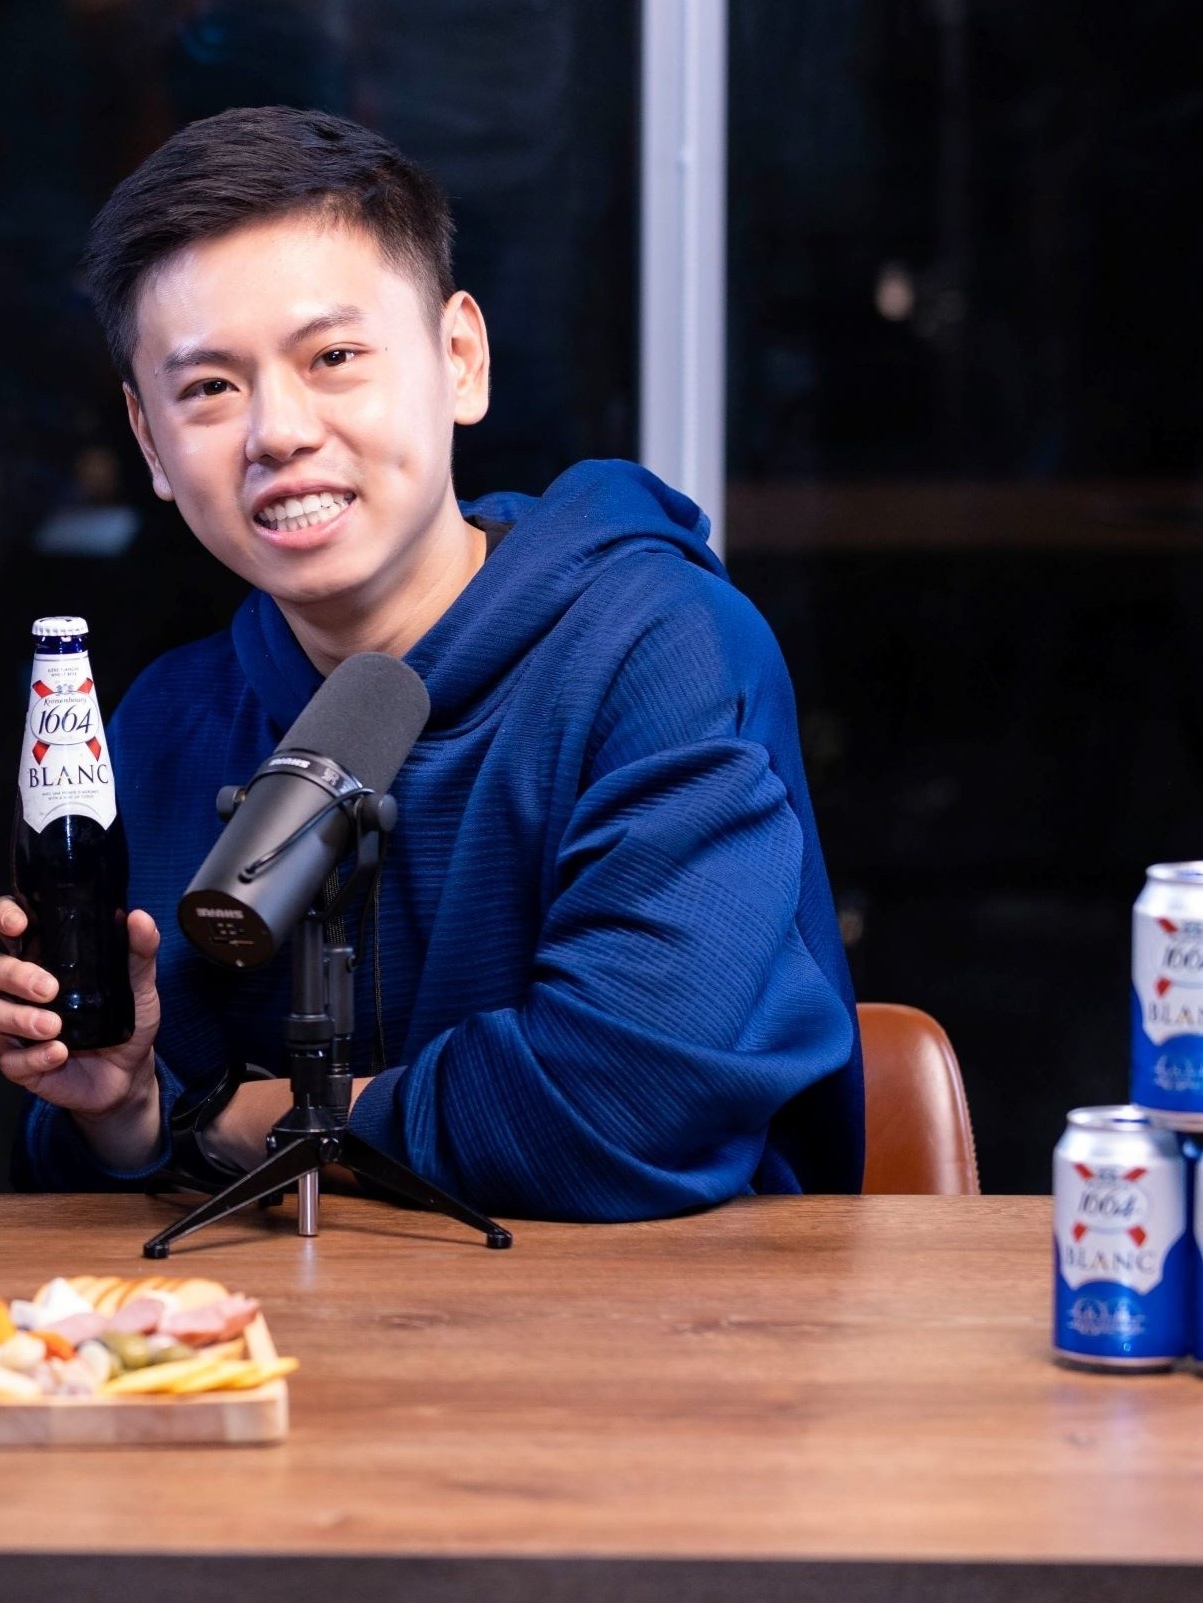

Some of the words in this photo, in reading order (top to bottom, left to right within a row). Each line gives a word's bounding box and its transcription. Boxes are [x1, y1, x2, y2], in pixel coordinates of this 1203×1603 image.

[38, 705, 93, 735] 1664
[29, 763, 109, 788] BLANC
[1161, 945, 1203, 969] 166
